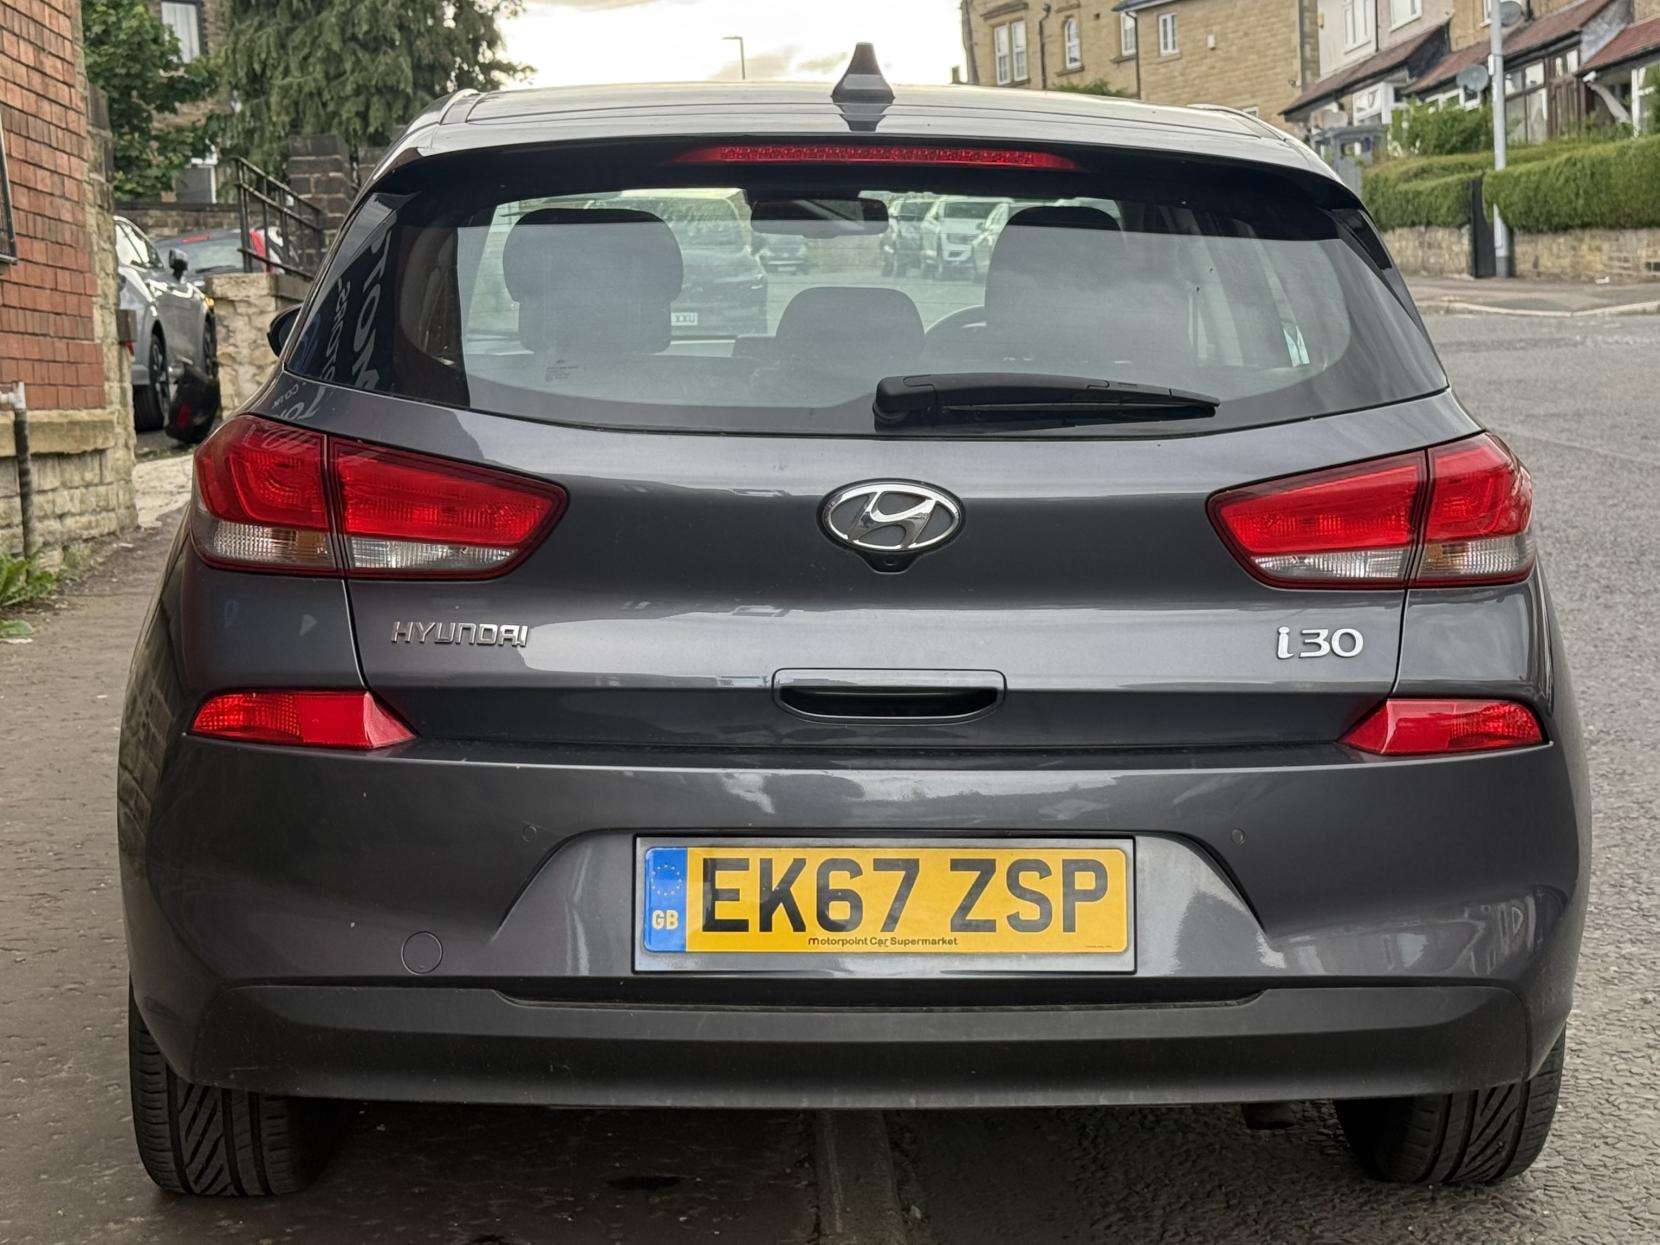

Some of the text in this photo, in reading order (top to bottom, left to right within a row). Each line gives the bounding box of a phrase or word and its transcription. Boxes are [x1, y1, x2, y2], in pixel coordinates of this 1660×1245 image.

[391, 620, 529, 647] HYUNDAI
[1277, 626, 1364, 659] i30
[702, 857, 1109, 933] EK67 ZSP
[652, 909, 679, 930] GB
[869, 936, 889, 947] Car
[890, 936, 959, 947] Supermarket
